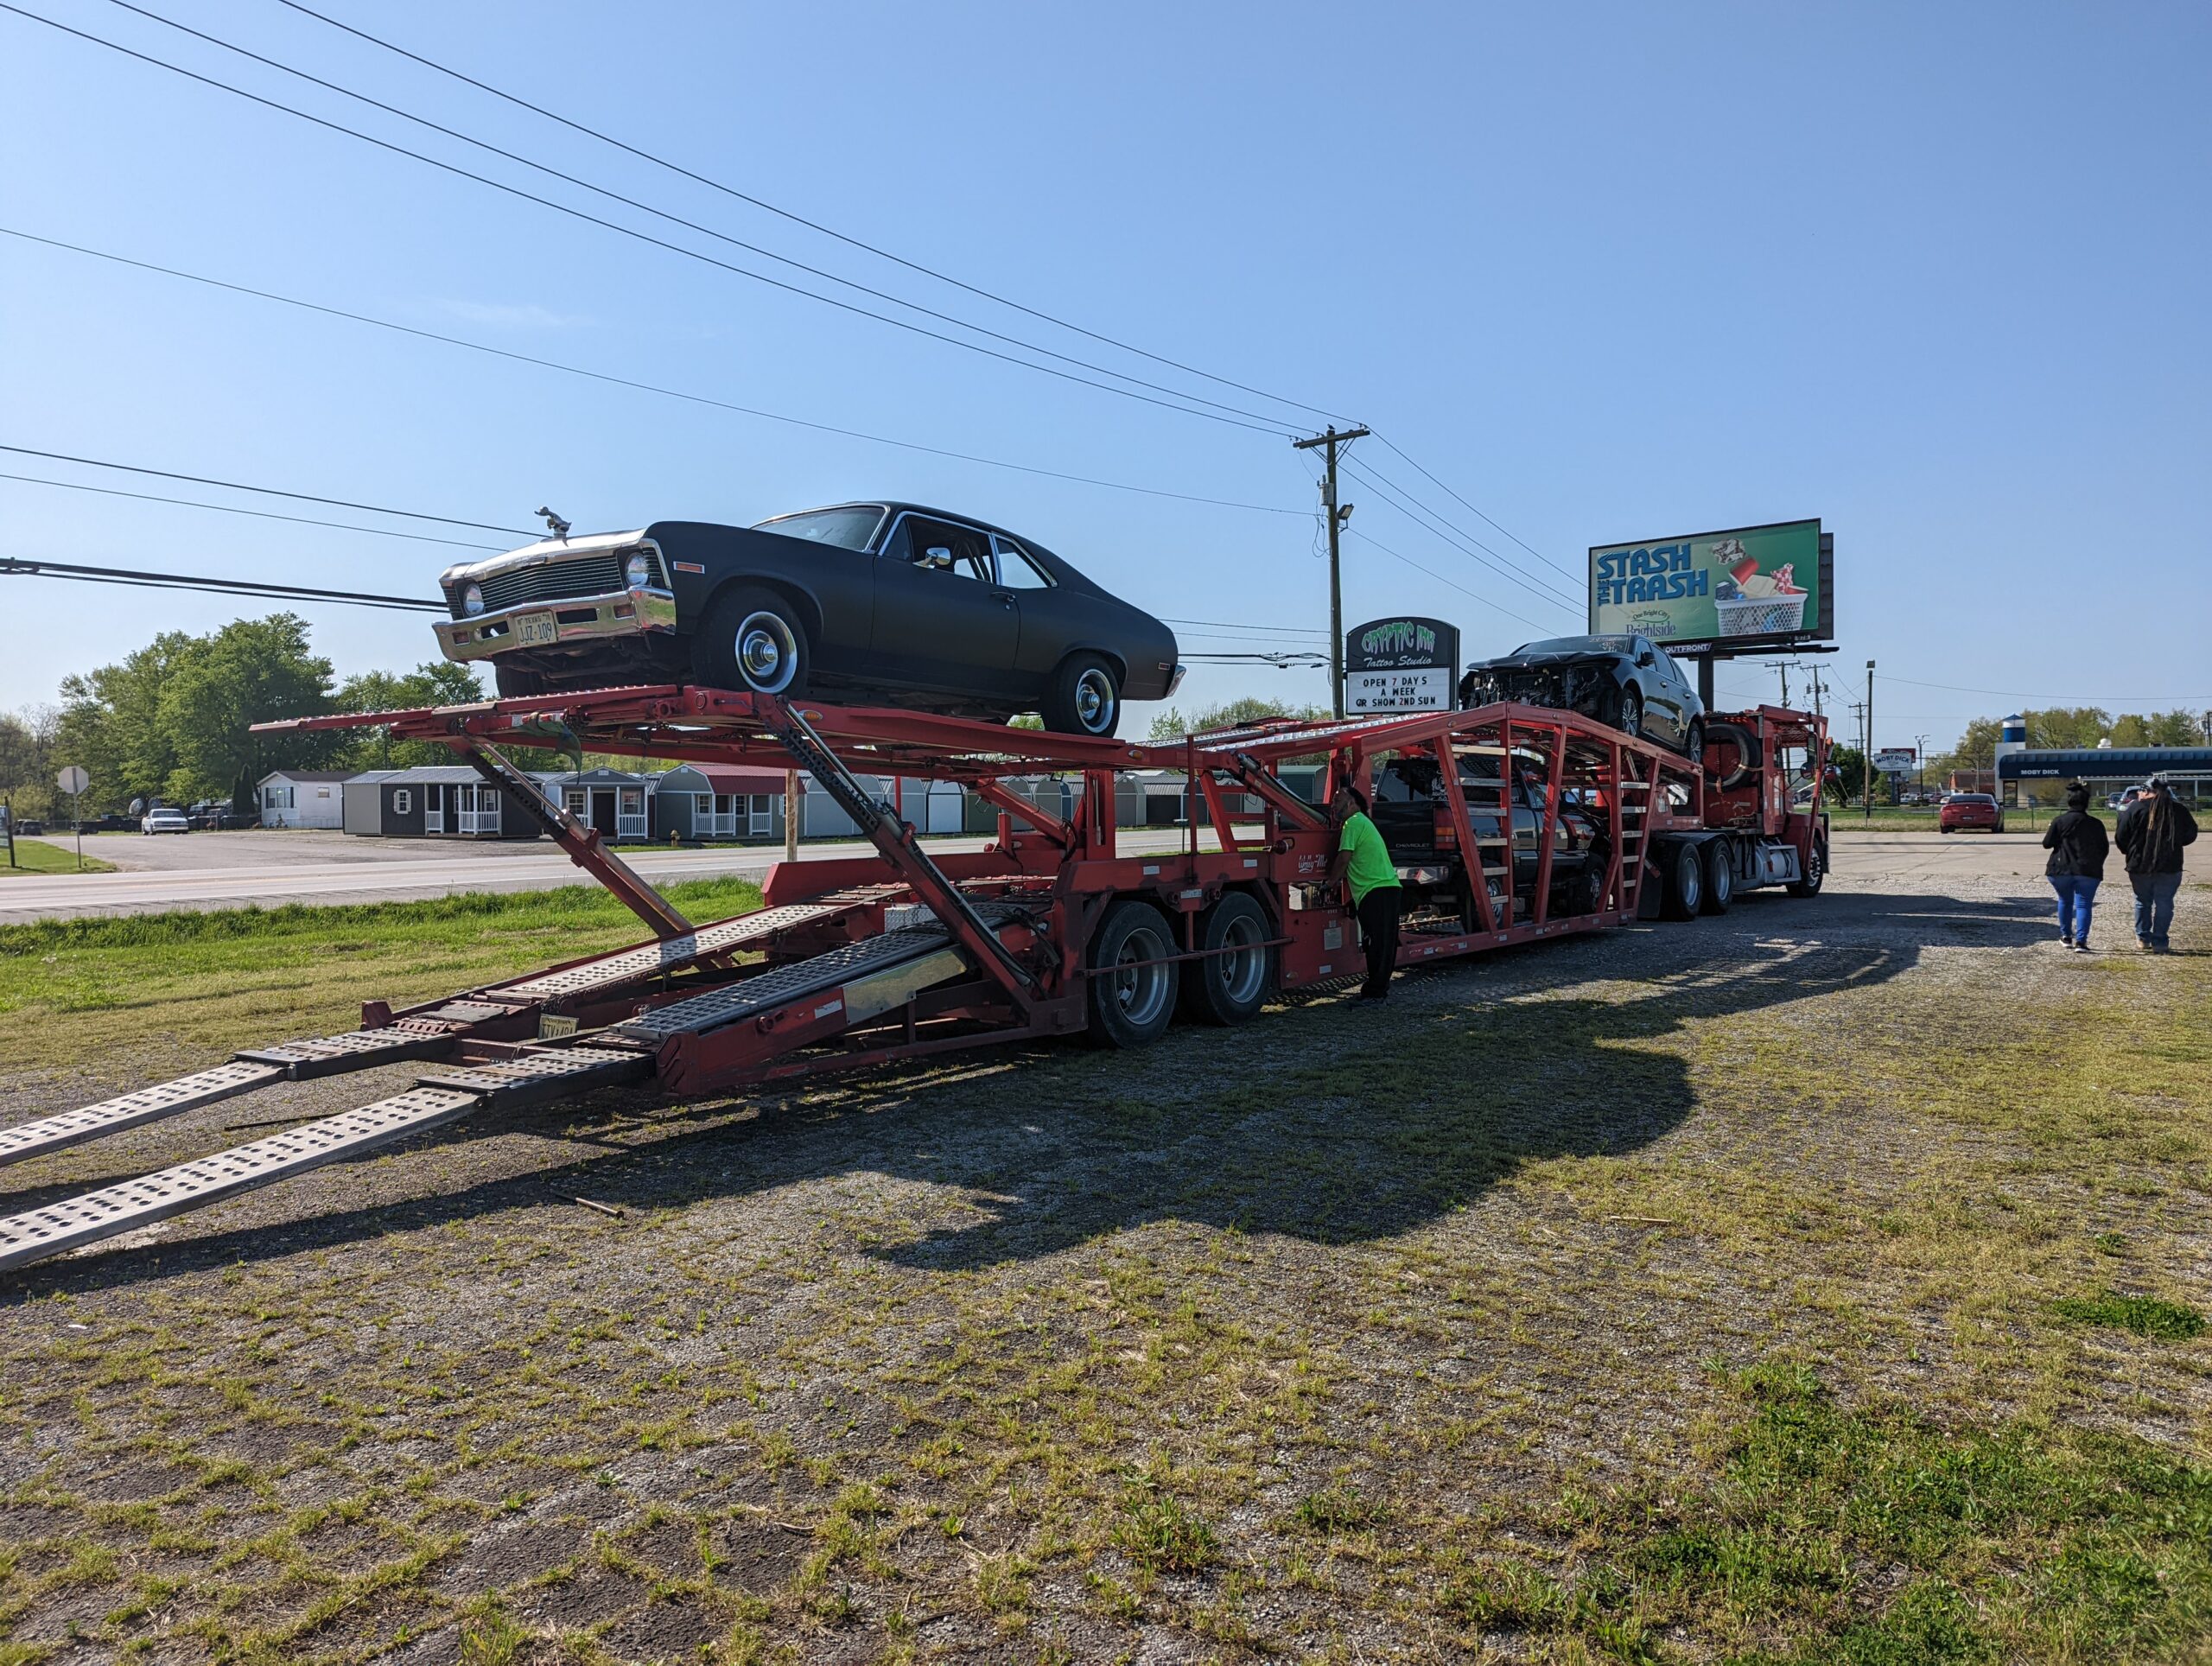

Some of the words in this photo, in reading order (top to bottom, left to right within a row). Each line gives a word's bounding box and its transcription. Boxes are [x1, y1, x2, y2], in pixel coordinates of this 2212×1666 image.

[1598, 543, 1691, 579] STASH
[1597, 579, 1610, 607] THE
[1610, 568, 1708, 604] TRASH
[1625, 620, 1676, 637] Brightside
[1362, 621, 1414, 655] CRYPTIC
[1417, 625, 1435, 652] INK
[1363, 657, 1394, 668] Tattoo
[1397, 655, 1433, 666] Studio
[1363, 678, 1386, 687] OPEN
[1392, 677, 1397, 686] 7
[1402, 677, 1427, 685] DAYS
[1381, 688, 1386, 696] A
[1392, 687, 1415, 696] WEEK
[1372, 698, 1395, 707] SHOW
[1399, 697, 1415, 706] 2ND
[1418, 696, 1436, 705] SUN
[1876, 755, 1893, 764] MOBY
[1894, 755, 1909, 764] DICK
